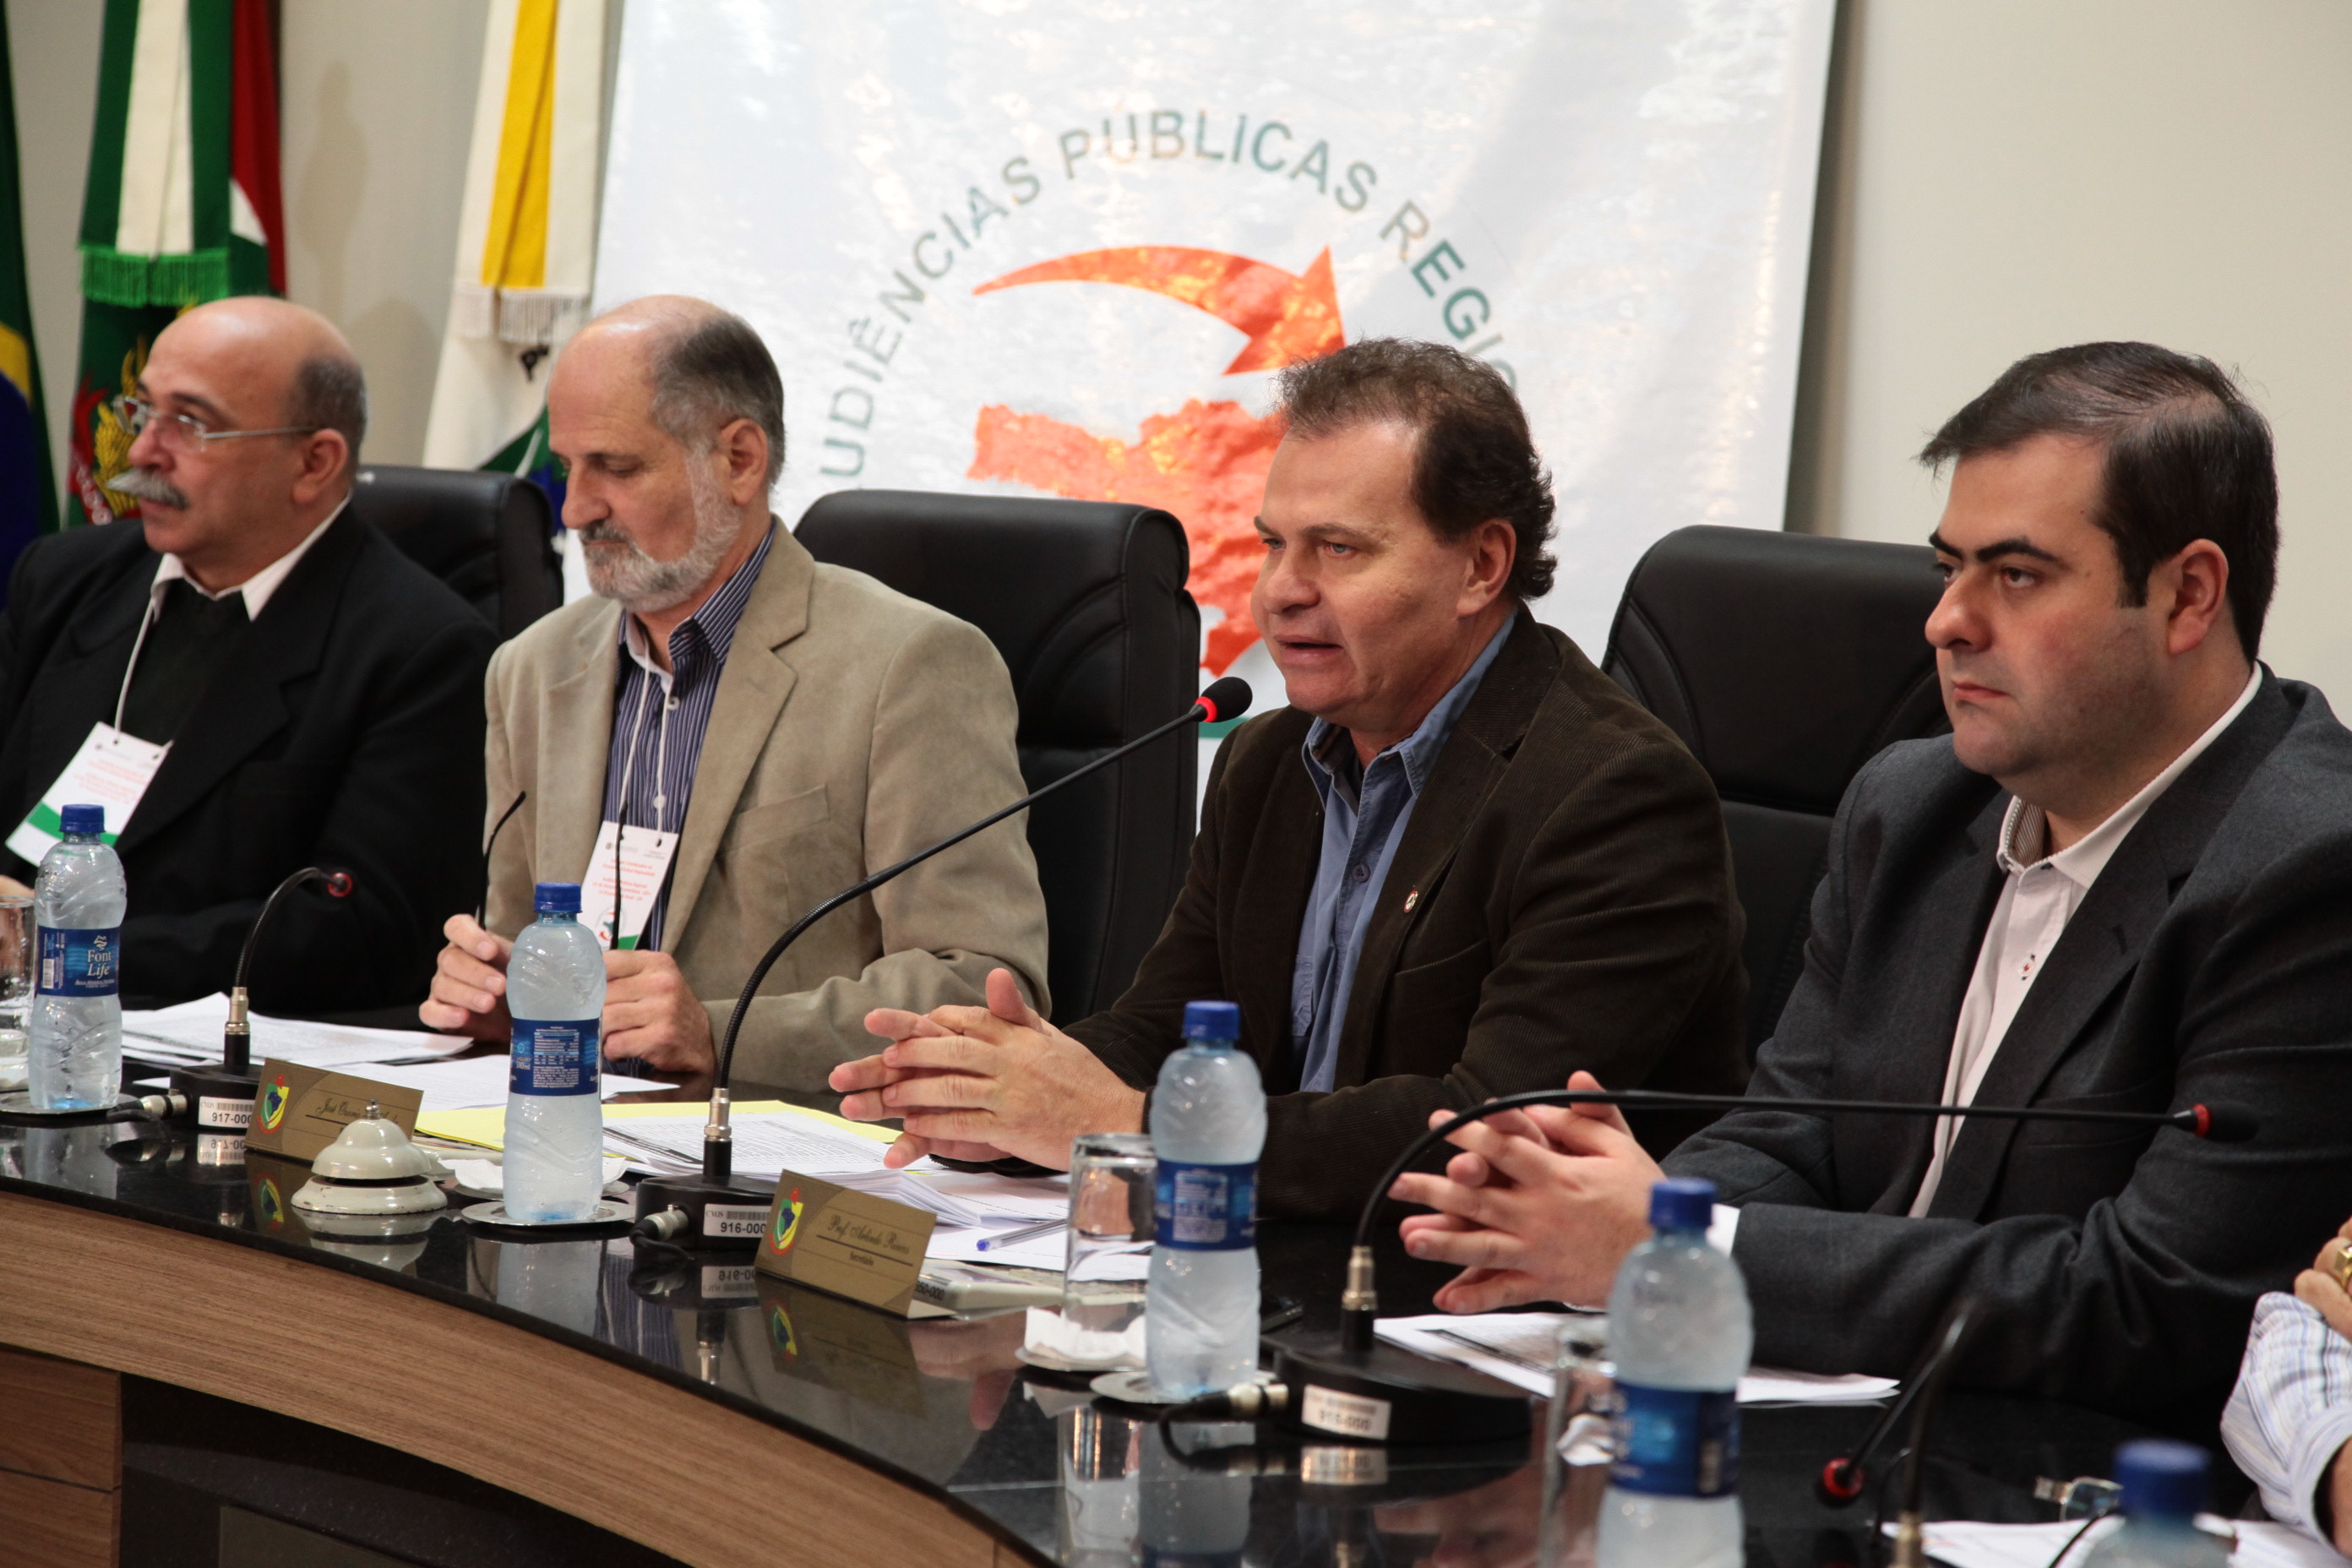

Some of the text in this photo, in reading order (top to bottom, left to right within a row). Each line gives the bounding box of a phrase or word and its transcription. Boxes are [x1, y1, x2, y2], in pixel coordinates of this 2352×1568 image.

[819, 155, 1042, 480] UDIÊNCIAS
[87, 949, 112, 963] Font
[87, 963, 110, 979] Life
